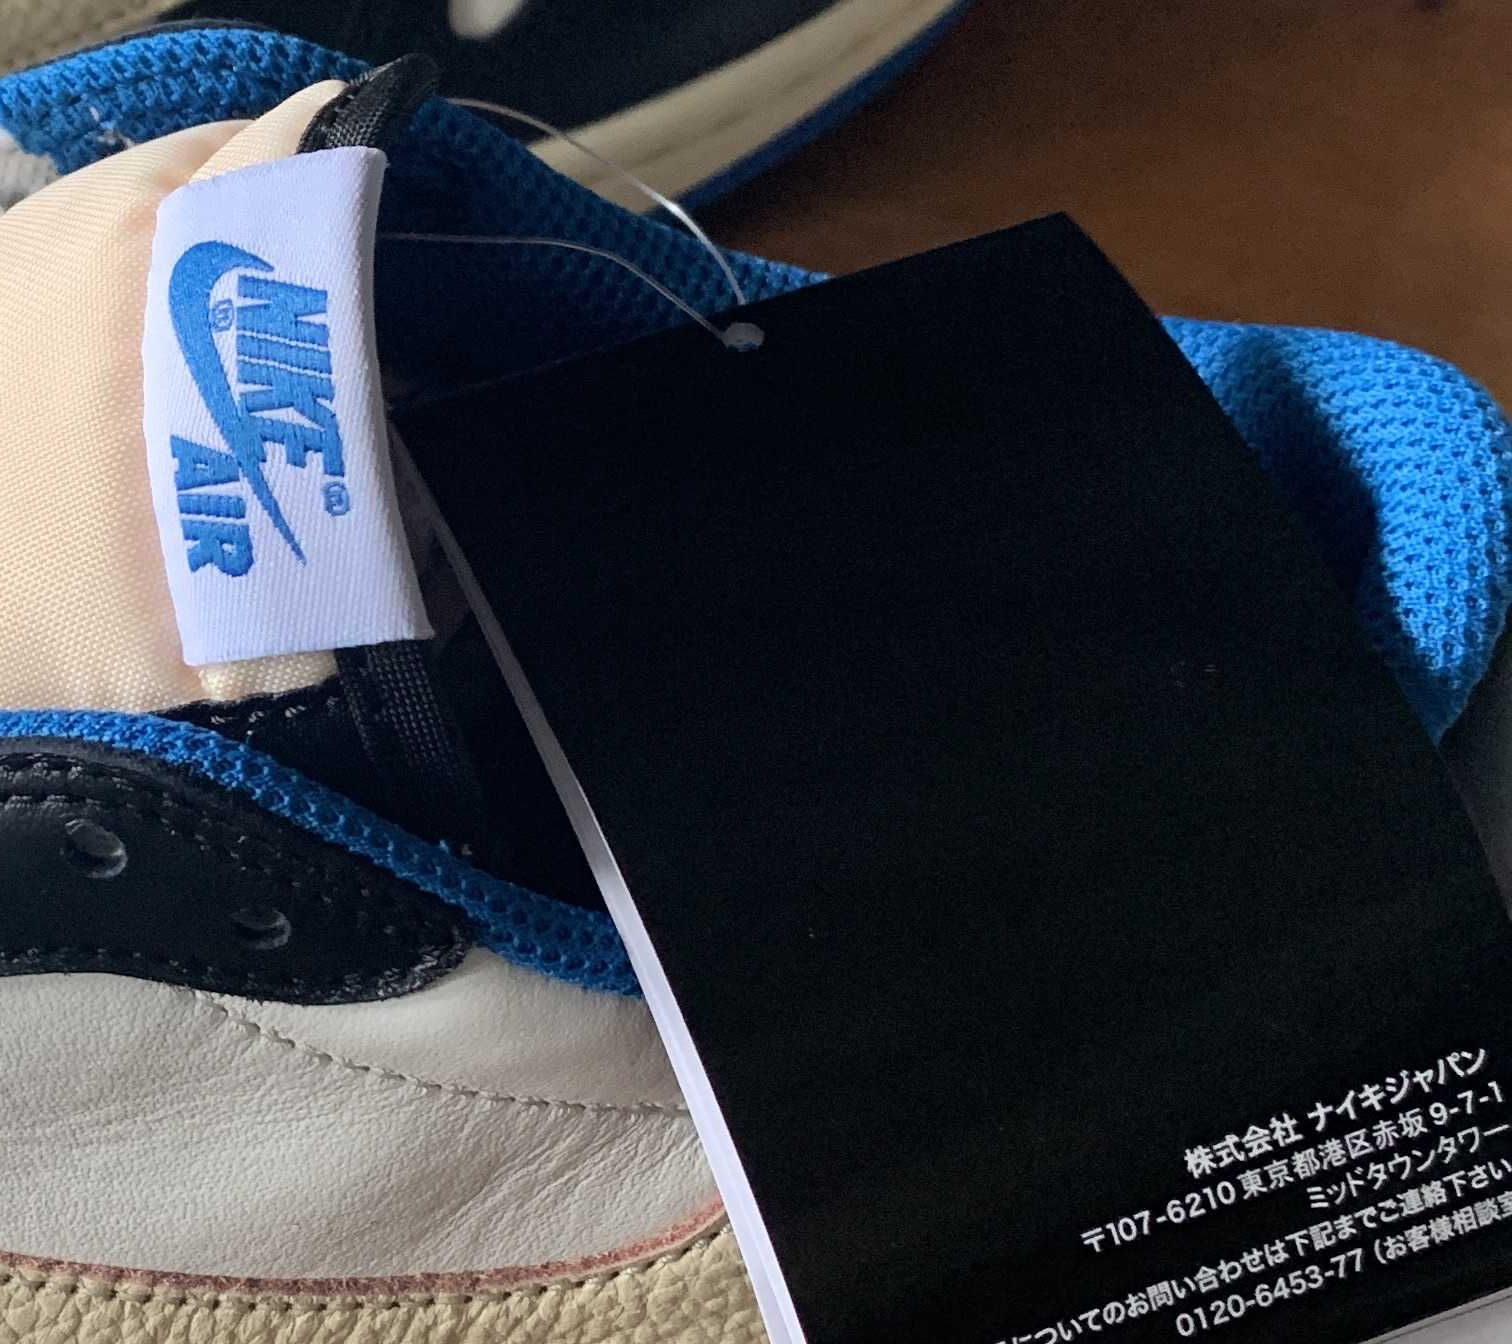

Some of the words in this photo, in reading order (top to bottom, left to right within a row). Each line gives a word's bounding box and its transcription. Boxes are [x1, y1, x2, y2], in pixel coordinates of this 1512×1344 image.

[170, 433, 255, 578] AIR
[1183, 1112, 1304, 1179] 株式会社
[1306, 1048, 1486, 1132] ナイキジャパン
[1236, 1107, 1429, 1200] 東京都港区赤坂
[1428, 1080, 1503, 1126] 9-7-1
[1306, 1123, 1511, 1209] ミッドタウンタワー
[1175, 1247, 1363, 1337] 0120-6453-77
